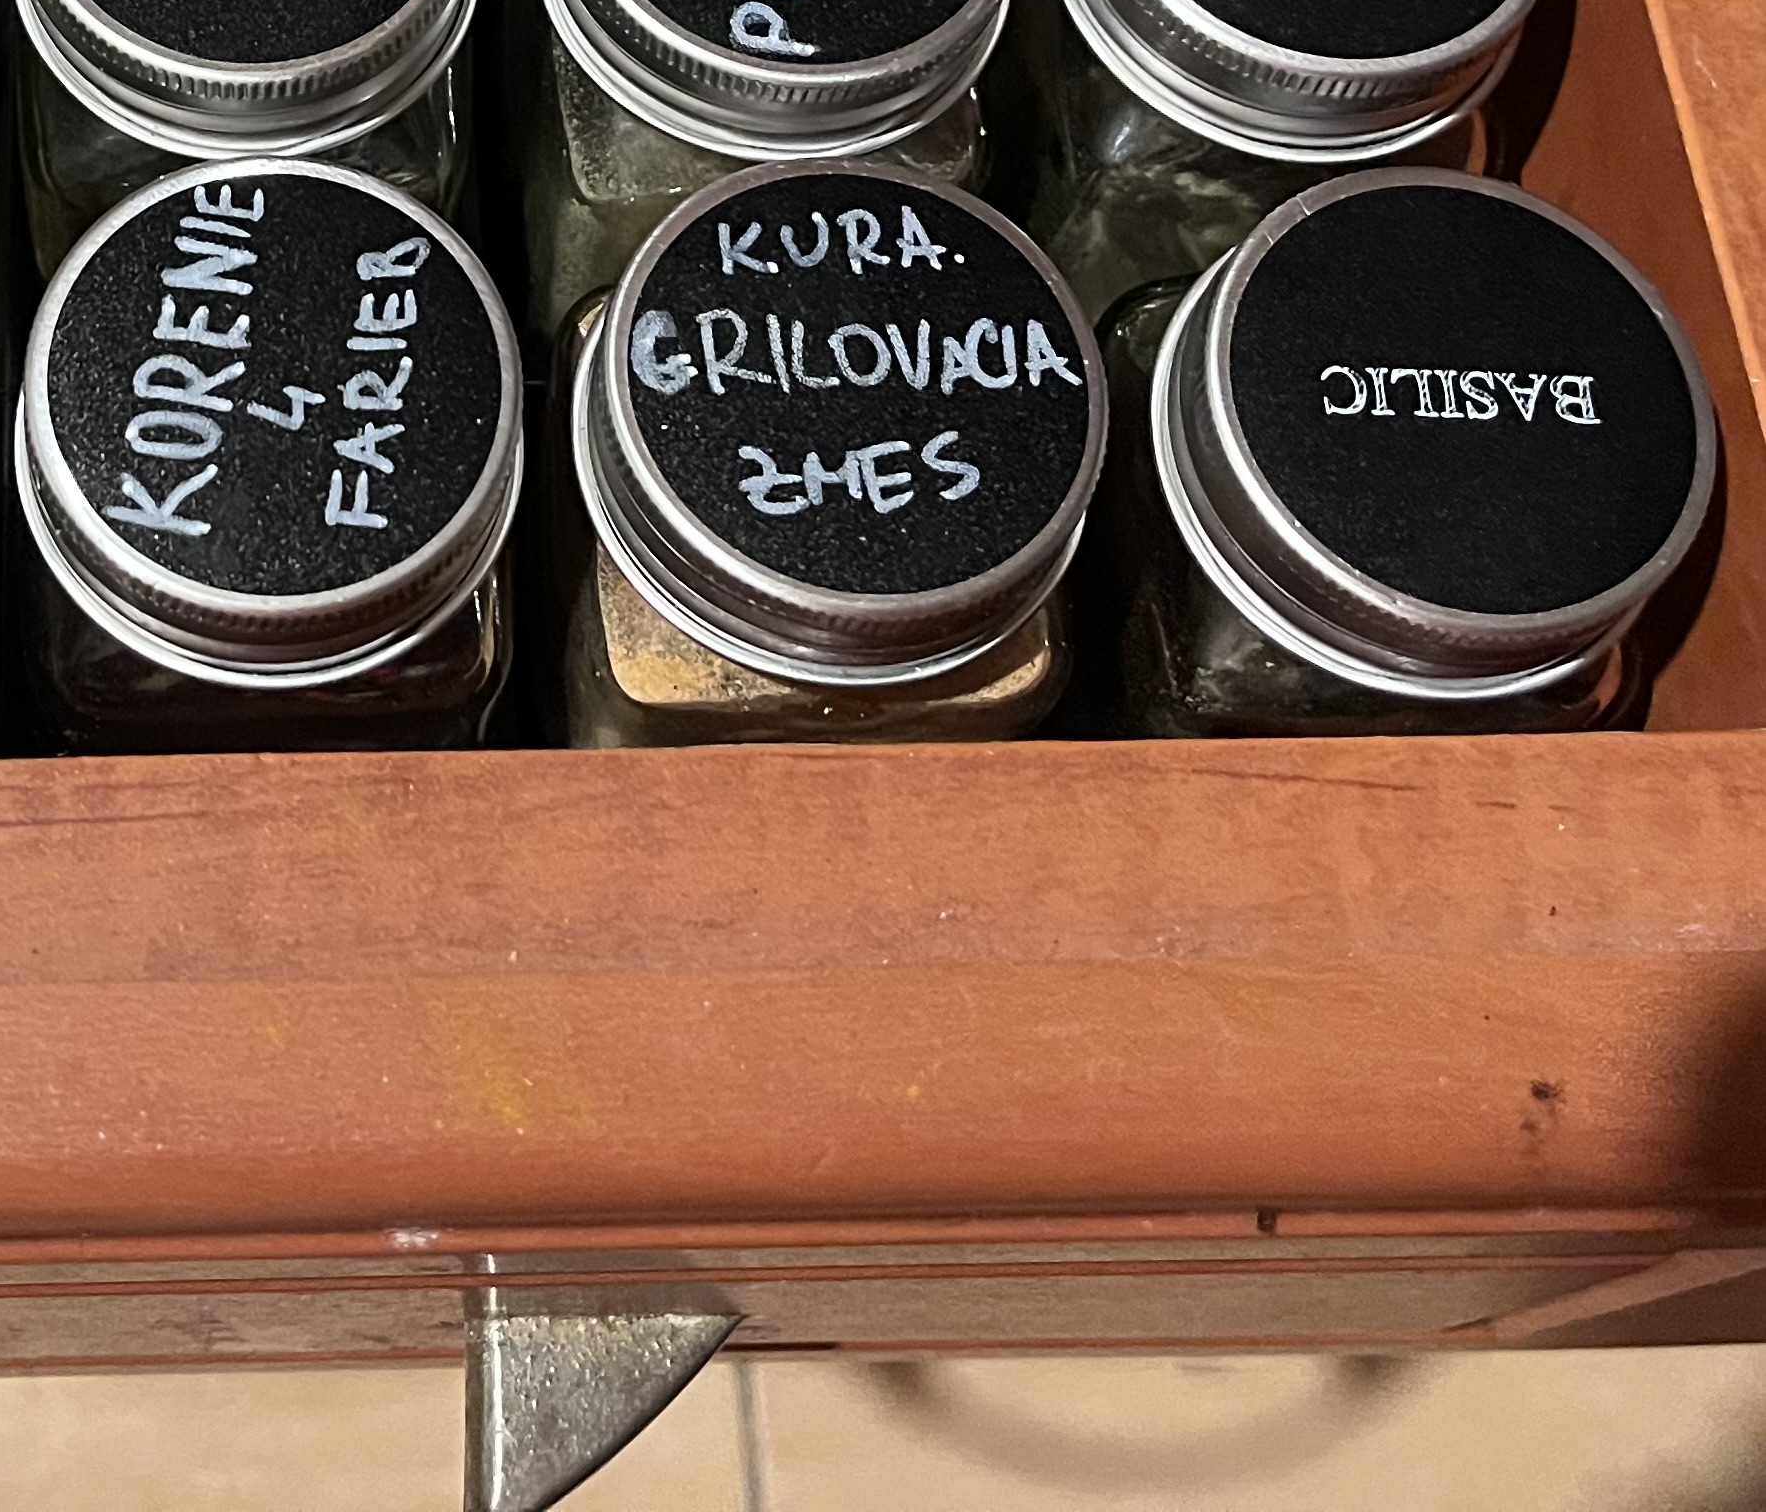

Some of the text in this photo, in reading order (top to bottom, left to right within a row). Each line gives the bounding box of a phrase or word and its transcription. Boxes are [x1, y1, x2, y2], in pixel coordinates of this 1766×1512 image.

[718, 205, 964, 275] KURA.
[105, 182, 266, 538] KORENIE
[326, 235, 432, 529] FARIEB
[630, 307, 1083, 397] GRILOVACIA
[1319, 365, 1603, 426] BASILIC
[248, 384, 326, 429] 4
[738, 429, 981, 516] ZMES
